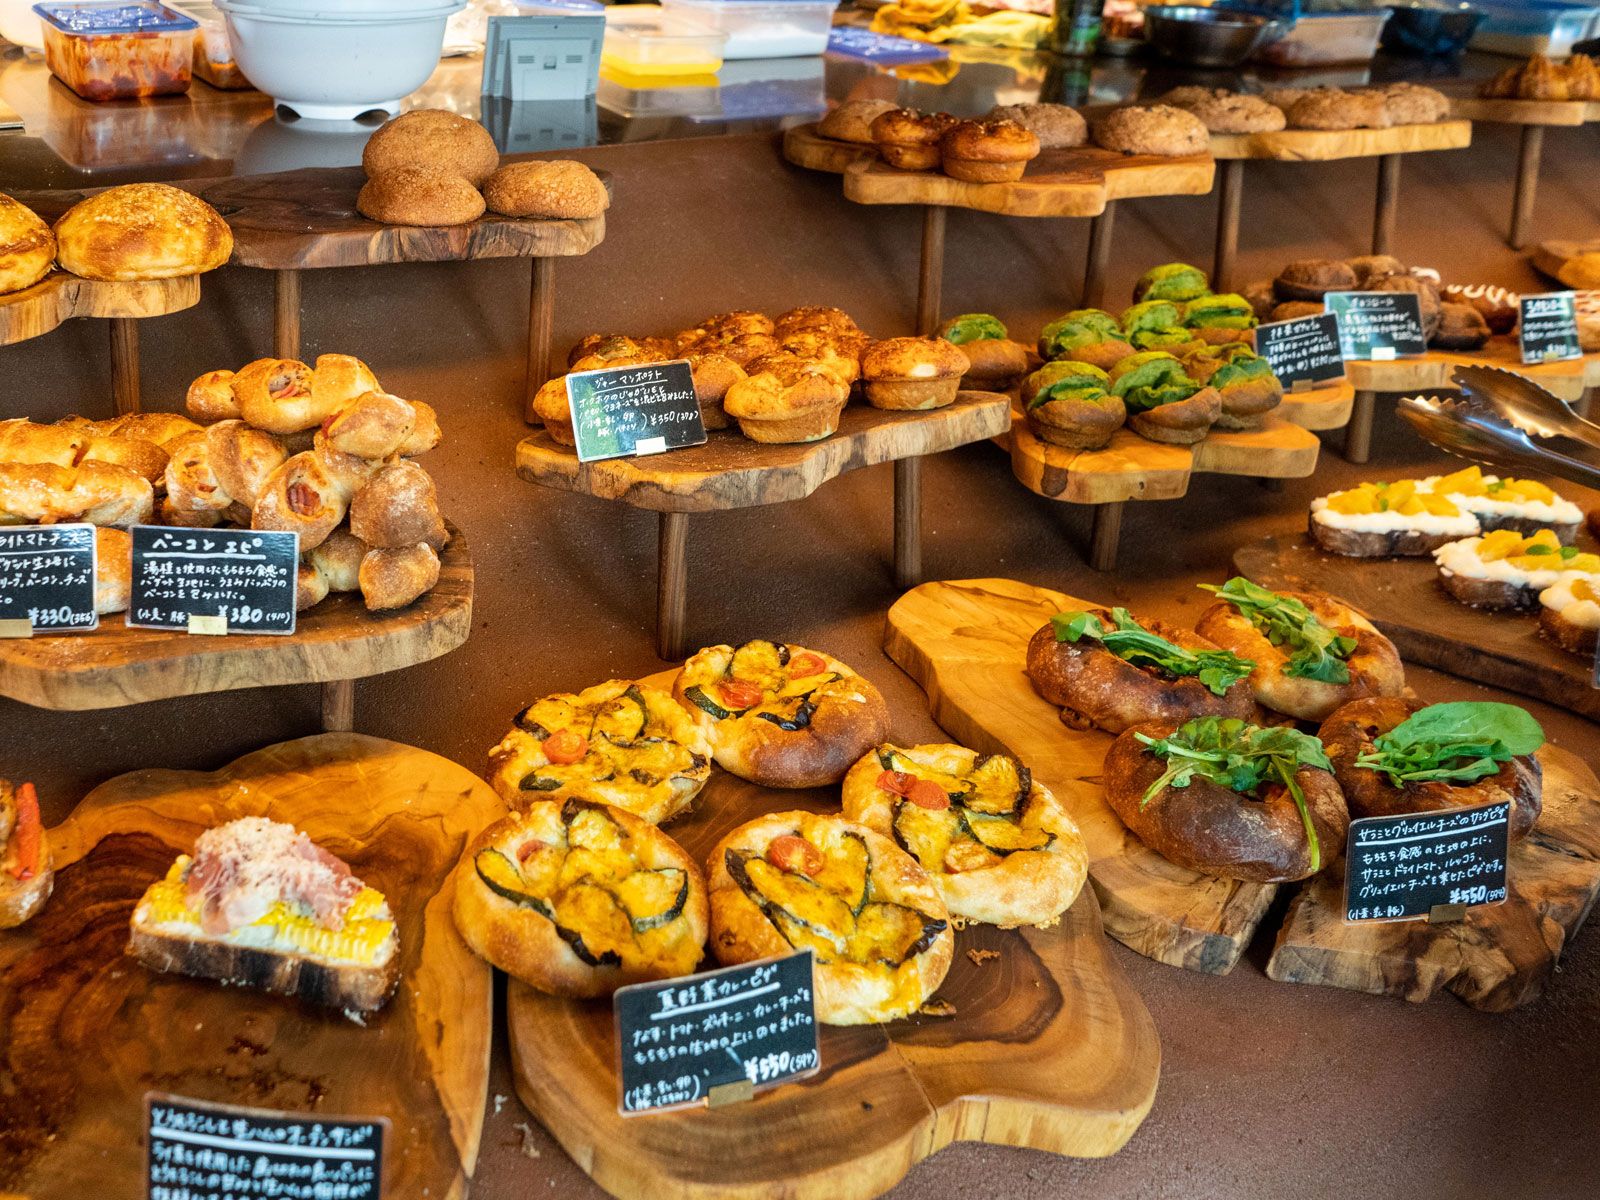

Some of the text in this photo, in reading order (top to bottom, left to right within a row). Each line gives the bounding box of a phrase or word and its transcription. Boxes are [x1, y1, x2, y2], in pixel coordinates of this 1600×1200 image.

[595, 369, 662, 389] ジャーマンポテト
